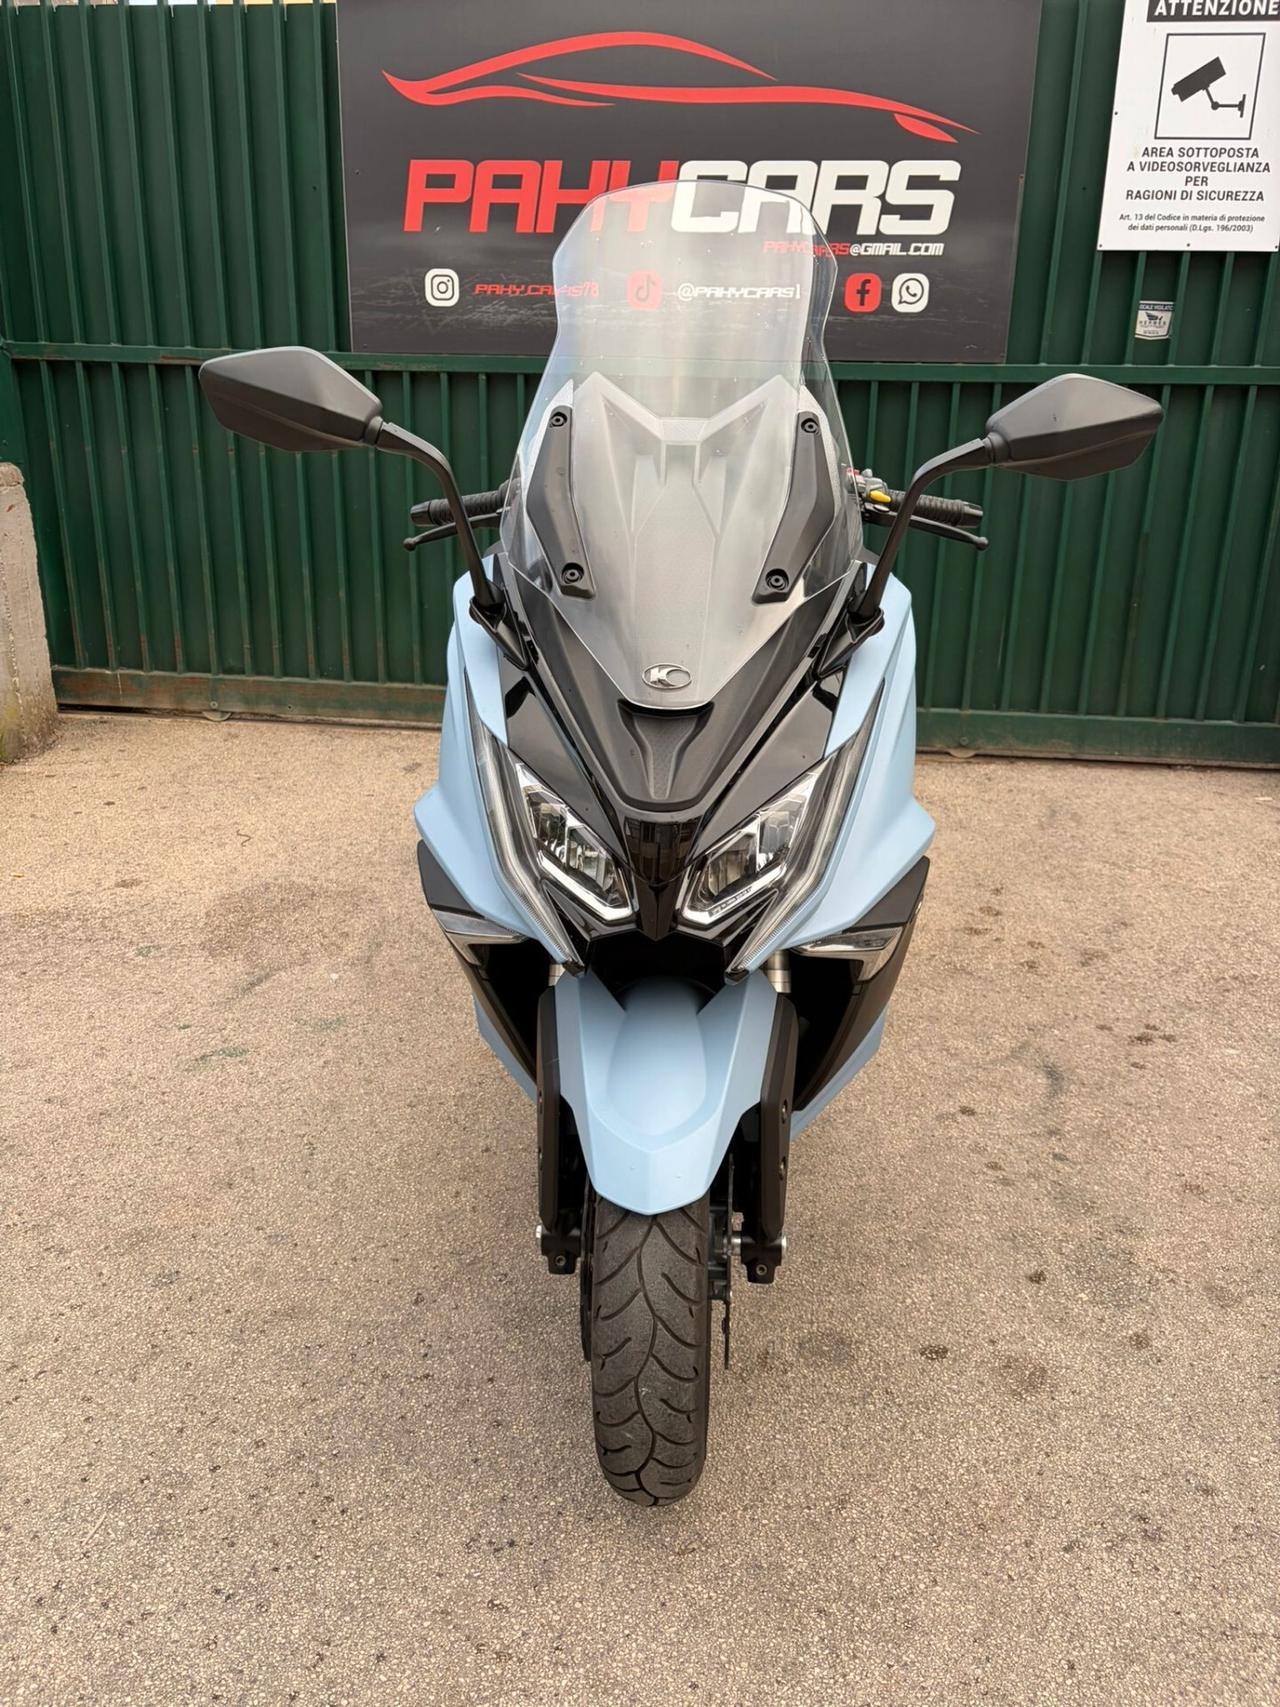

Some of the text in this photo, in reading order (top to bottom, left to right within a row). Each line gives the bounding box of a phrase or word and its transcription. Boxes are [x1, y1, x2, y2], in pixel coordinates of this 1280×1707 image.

[1154, 0, 1280, 16] ATTENZIONE
[1141, 147, 1260, 159] AREA SOTTOPOSTA
[1126, 161, 1271, 173] A VIDEOSORVEGLIANZA
[1184, 175, 1209, 187] PER
[1126, 189, 1265, 202] RAGIONI DI SICUREZZA
[1190, 214, 1218, 222] materia
[1219, 214, 1226, 222] di
[1227, 215, 1266, 223] protezione
[1127, 223, 1140, 231] dei
[1140, 223, 1154, 231] dati
[1155, 224, 1188, 232] personali
[1216, 224, 1254, 233] 196/2003)
